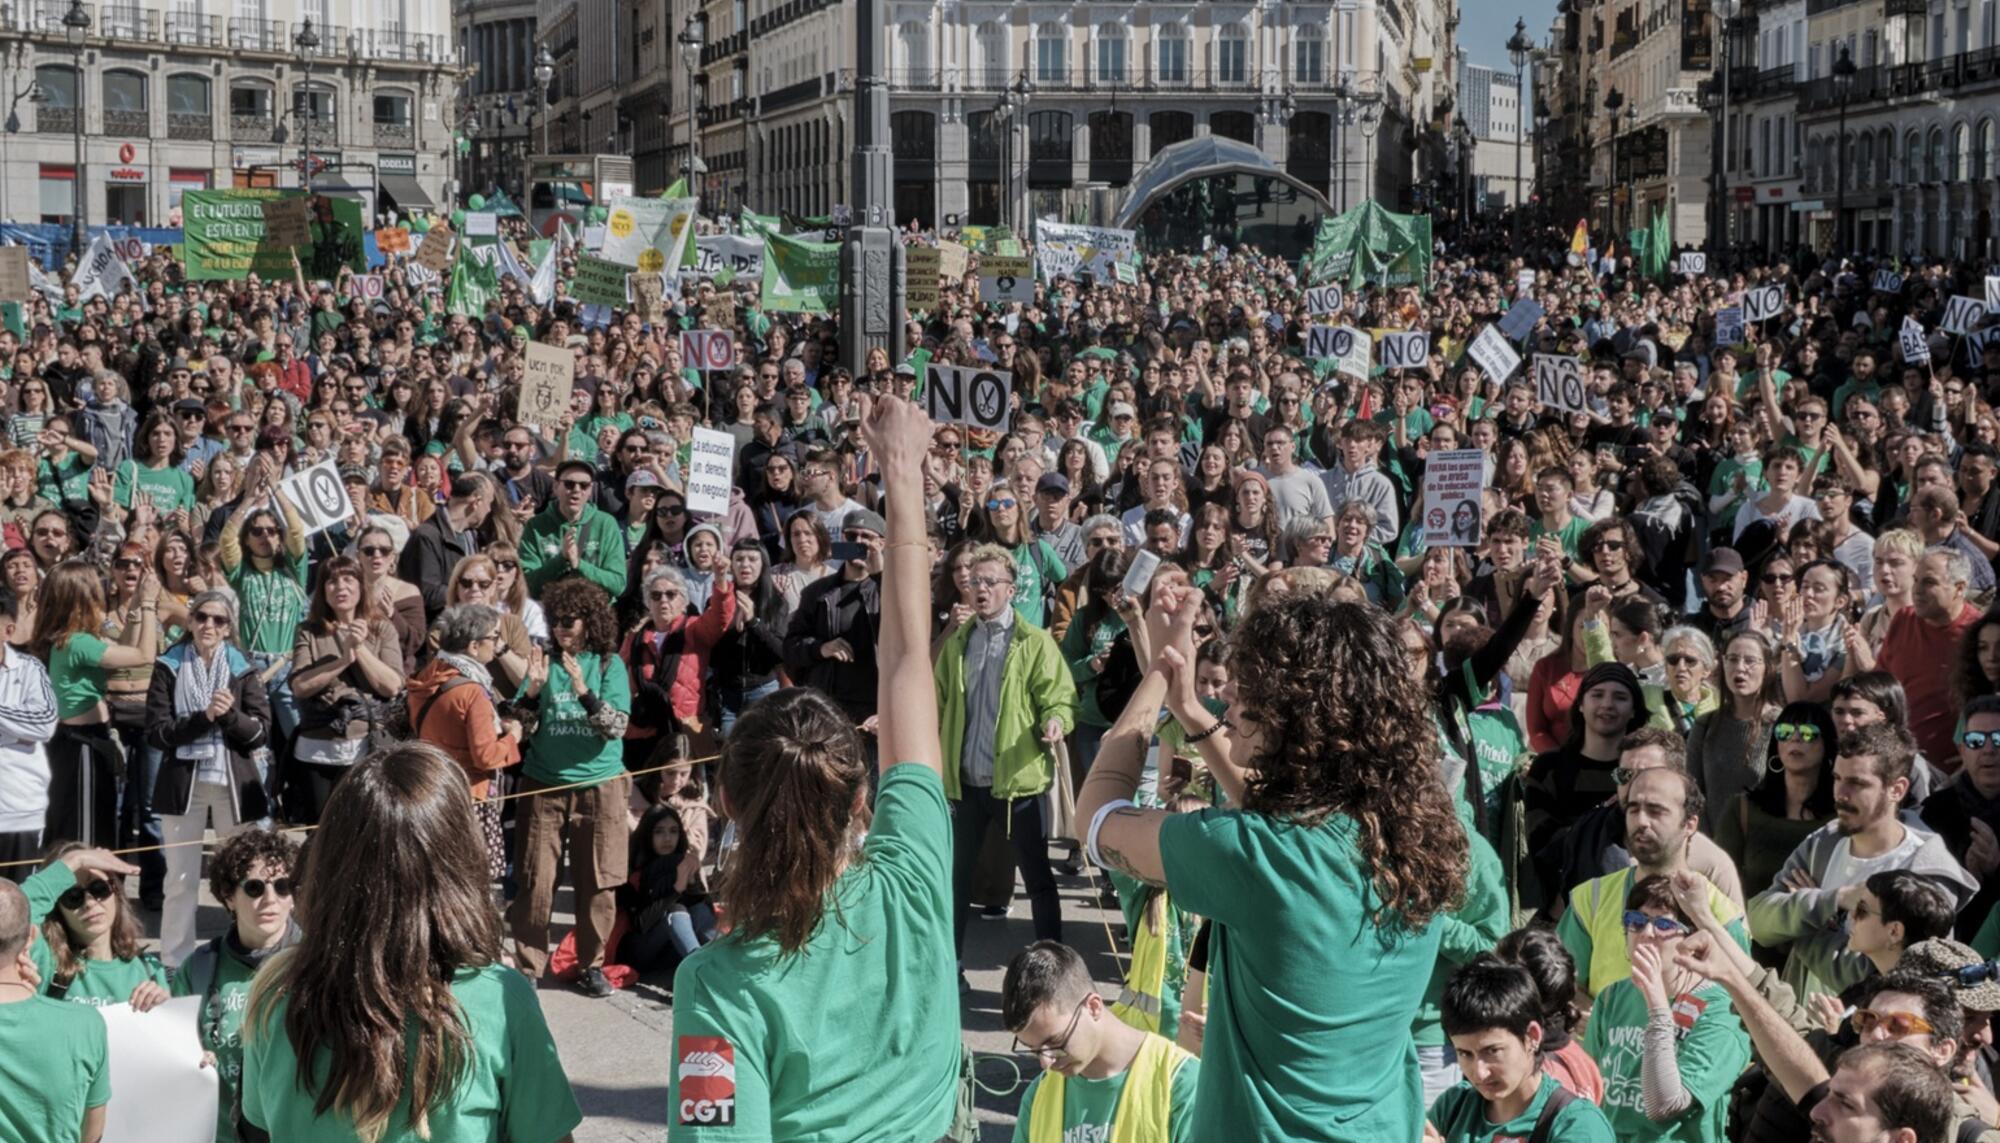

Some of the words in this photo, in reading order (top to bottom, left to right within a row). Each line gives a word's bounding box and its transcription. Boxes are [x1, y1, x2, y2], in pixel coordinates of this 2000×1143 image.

[1682, 255, 1704, 270] NO
[351, 276, 382, 299] NO
[1875, 271, 1901, 291] NO
[1308, 287, 1340, 313] NO
[1743, 287, 1782, 319] NO
[1943, 298, 1983, 331] NO
[683, 332, 732, 367] NO
[1308, 327, 1353, 357] NO
[1384, 335, 1426, 365] NO
[928, 367, 1006, 426] NO
[1540, 365, 1583, 409] NO
[693, 440, 700, 452] La
[693, 462, 702, 472] un
[1429, 463, 1447, 471] FUERA
[690, 483, 700, 493] no
[680, 1099, 735, 1122] CGT
